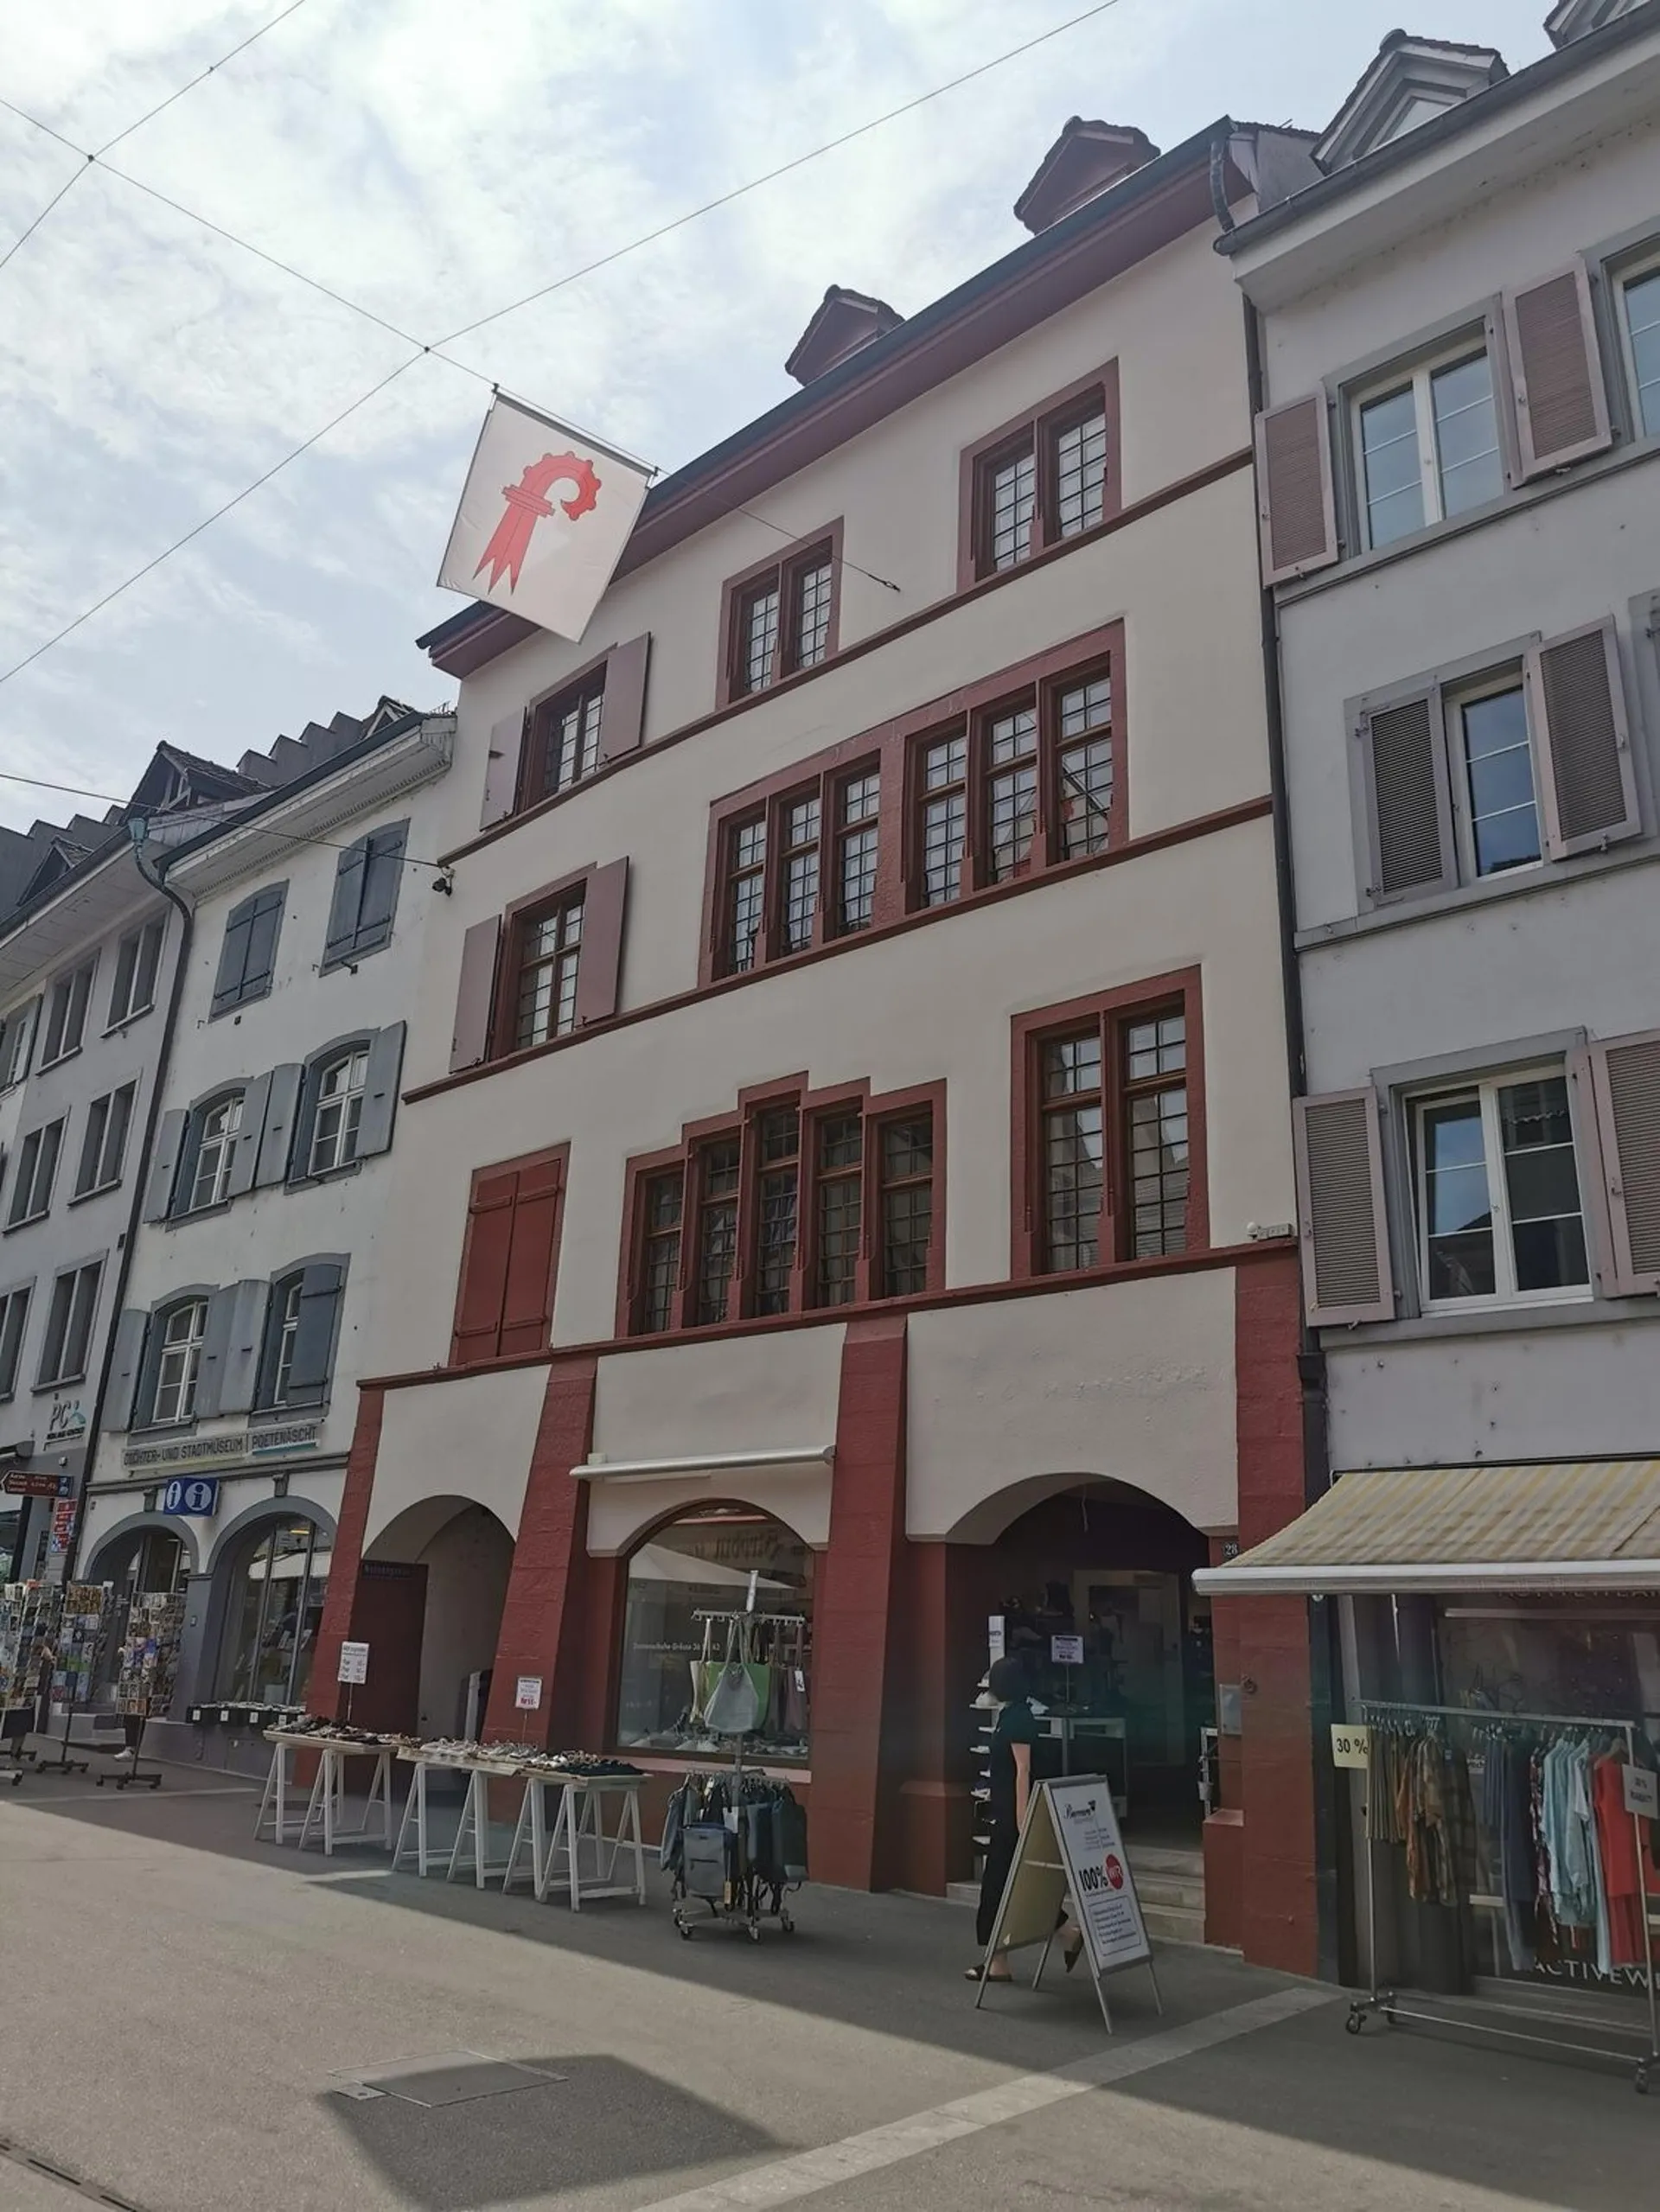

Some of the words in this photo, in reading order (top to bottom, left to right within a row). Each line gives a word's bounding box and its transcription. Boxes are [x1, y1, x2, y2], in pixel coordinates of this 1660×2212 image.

[1225, 1543, 1238, 1556] 28
[1337, 1737, 1350, 1754] 30
[1354, 1737, 1369, 1754] %
[1078, 1865, 1108, 1891] 100%
